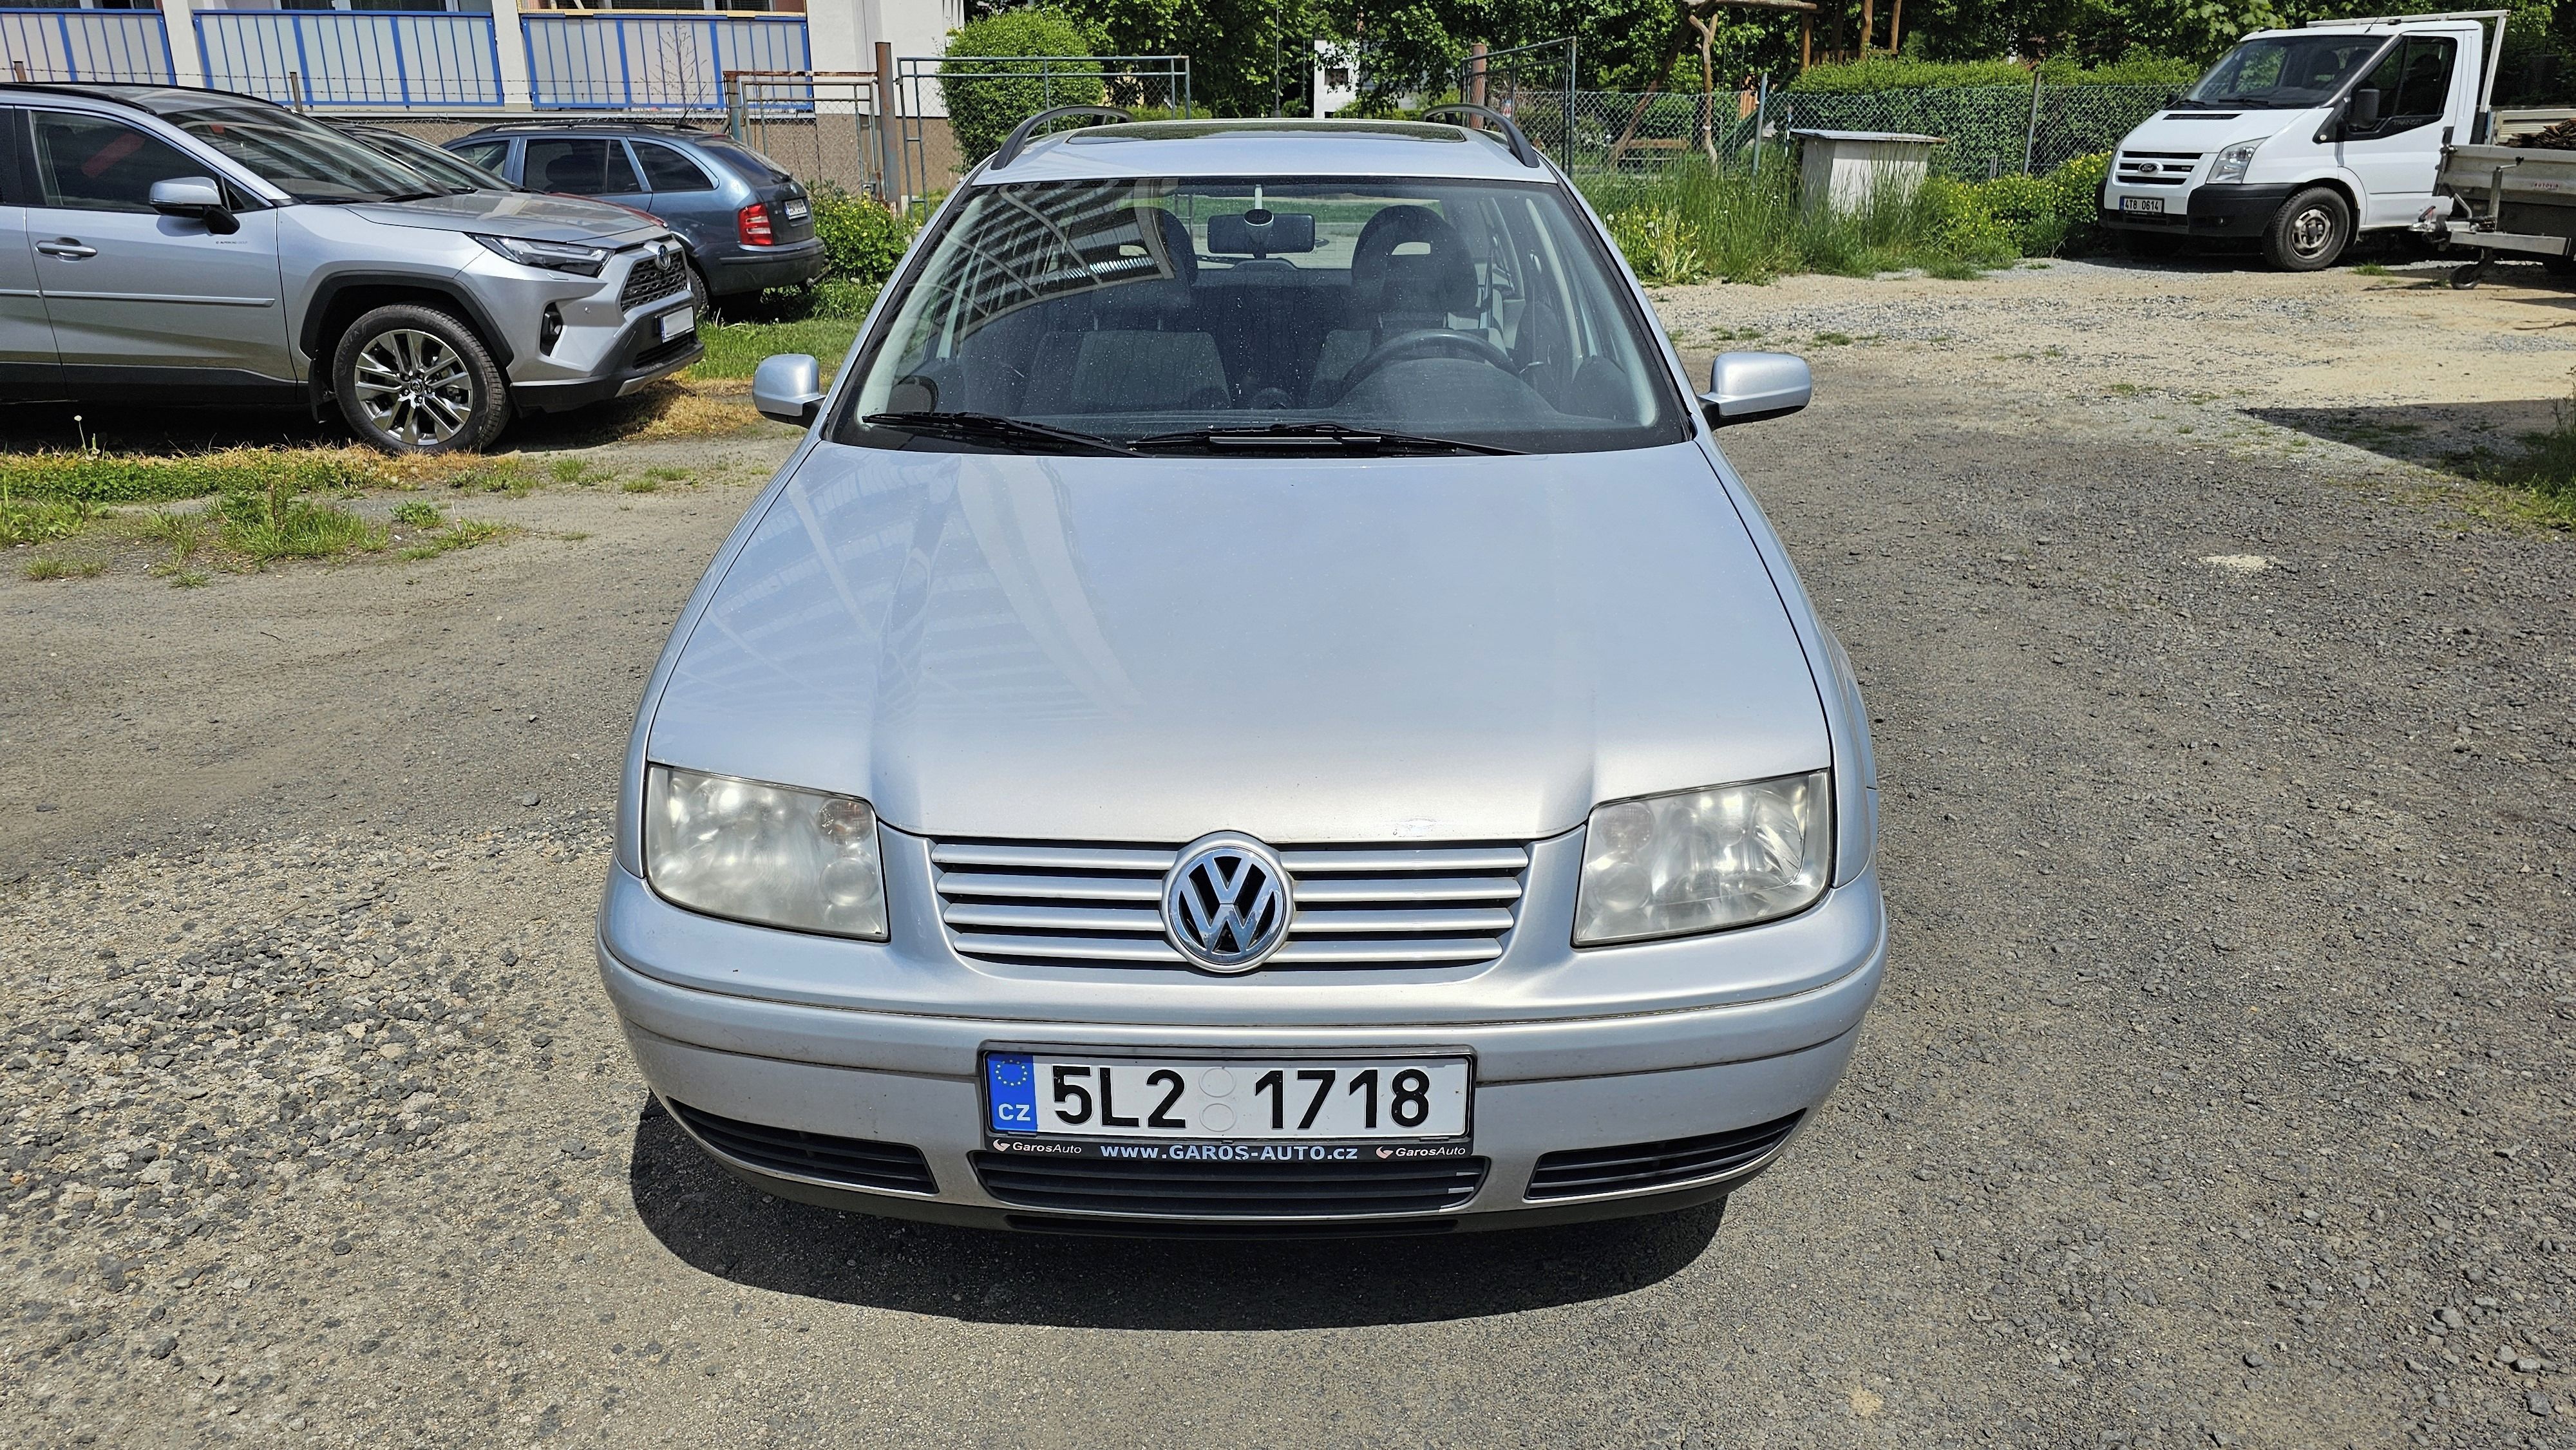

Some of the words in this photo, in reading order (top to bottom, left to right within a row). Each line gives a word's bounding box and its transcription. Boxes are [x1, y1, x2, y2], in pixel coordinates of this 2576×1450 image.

[2125, 200, 2137, 210] 4T8
[2141, 200, 2159, 211] 0614
[1053, 1065, 1186, 1129] 5L2
[1255, 1068, 1430, 1129] 1718
[998, 1103, 1030, 1121] CZ
[1012, 1142, 1083, 1154] GarosAuto
[1100, 1145, 1358, 1160] www.GAROS-AUTO.cz
[1395, 1146, 1466, 1157] GarosAuto
